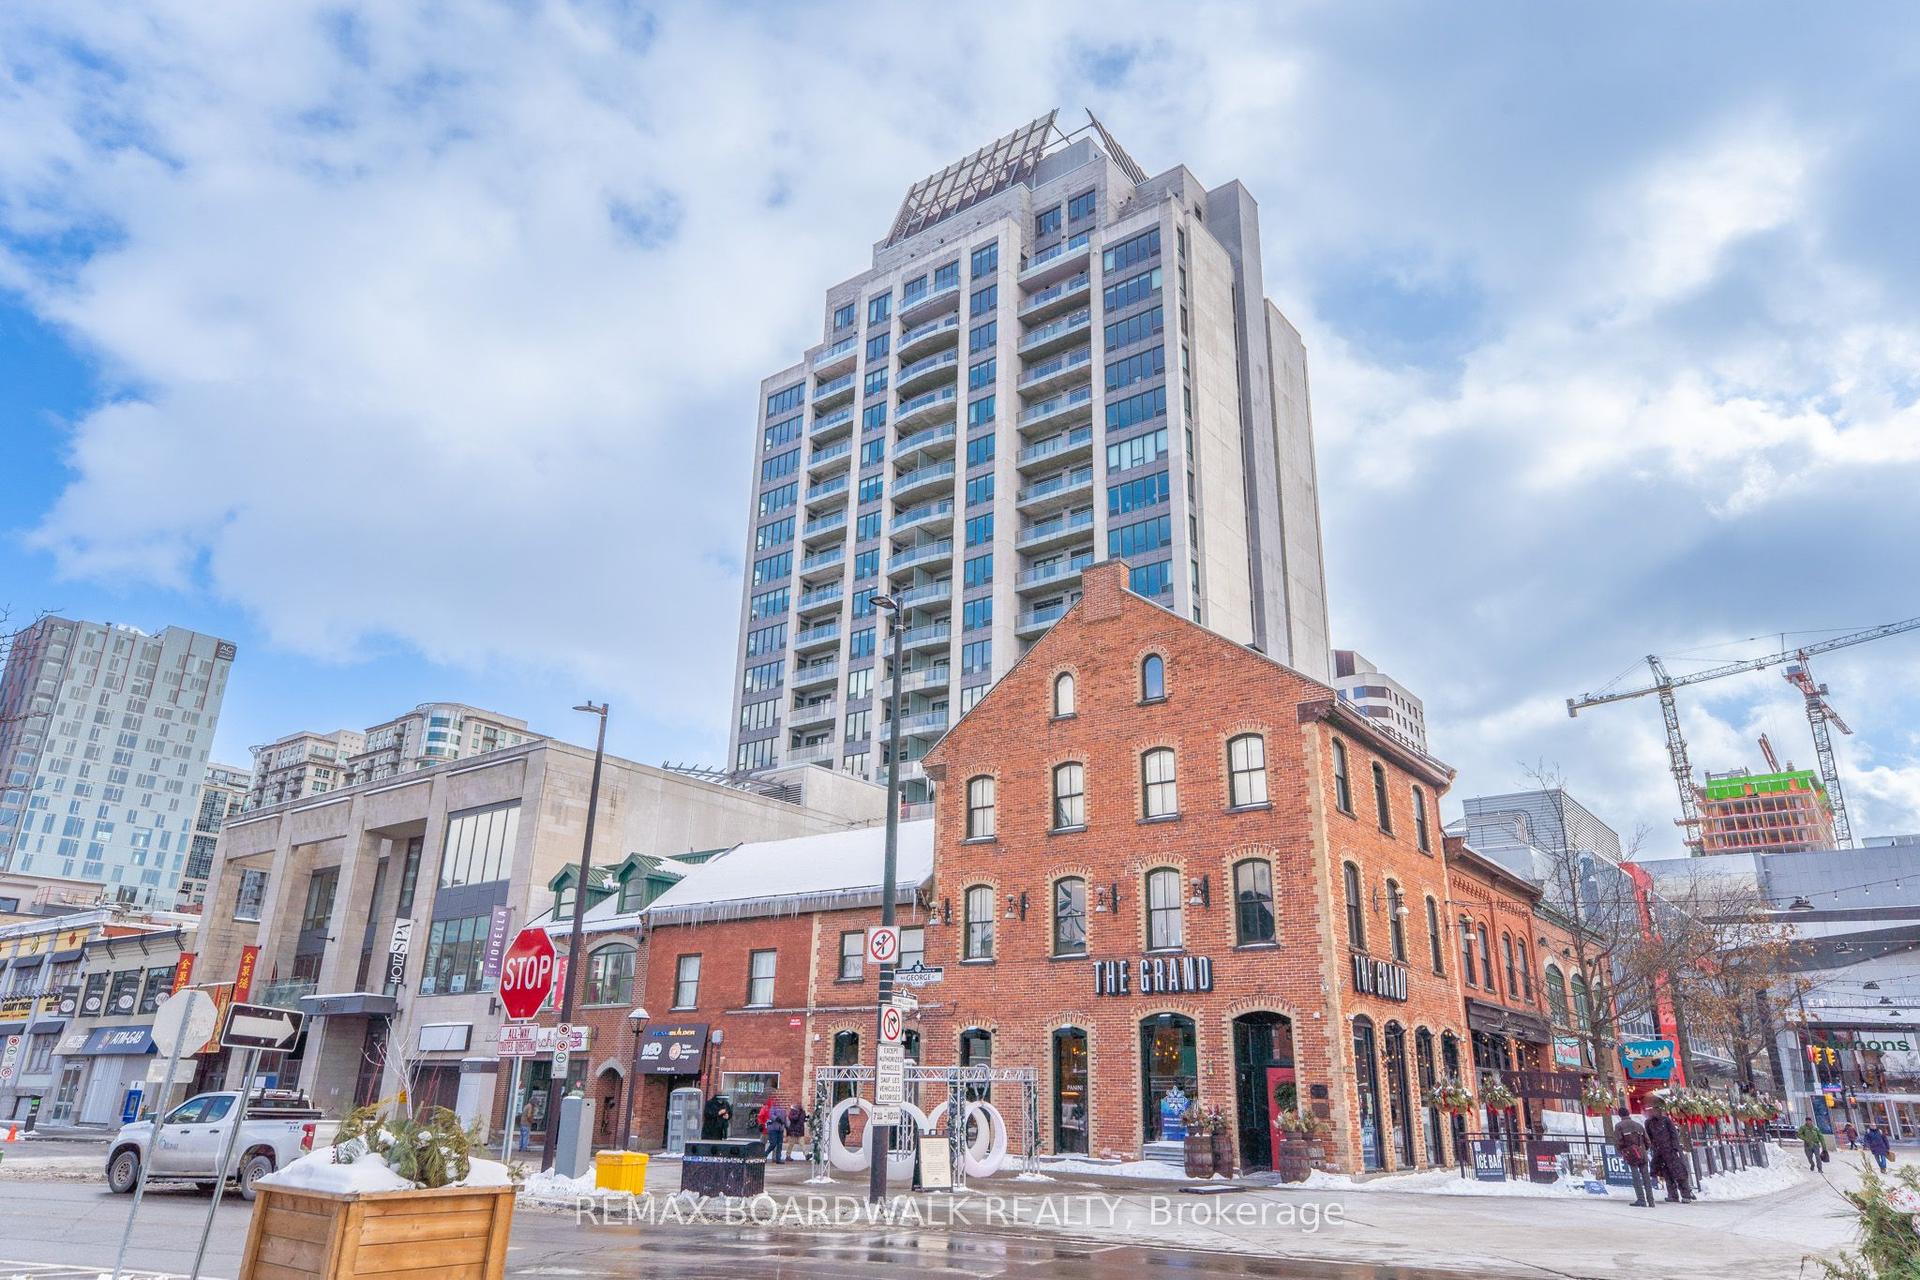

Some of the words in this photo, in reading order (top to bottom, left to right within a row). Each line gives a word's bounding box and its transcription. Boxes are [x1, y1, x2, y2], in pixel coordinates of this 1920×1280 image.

[488, 910, 507, 969] FIORELLA
[503, 955, 551, 991] STOP
[1093, 959, 1130, 996] THE
[1139, 956, 1213, 994] GRAND
[1353, 954, 1374, 993] THE
[1377, 961, 1407, 1000] GRAND
[1831, 998, 1874, 1007] Rideau
[507, 1027, 530, 1039] ALL-WAY
[883, 1047, 899, 1055] EXCEPT
[879, 1056, 904, 1064] AUTHORIZED
[881, 1064, 900, 1072] VEHICLES
[1475, 1154, 1488, 1169] ICE
[1488, 1154, 1502, 1168] BAR
[1606, 1157, 1626, 1172] ICE
